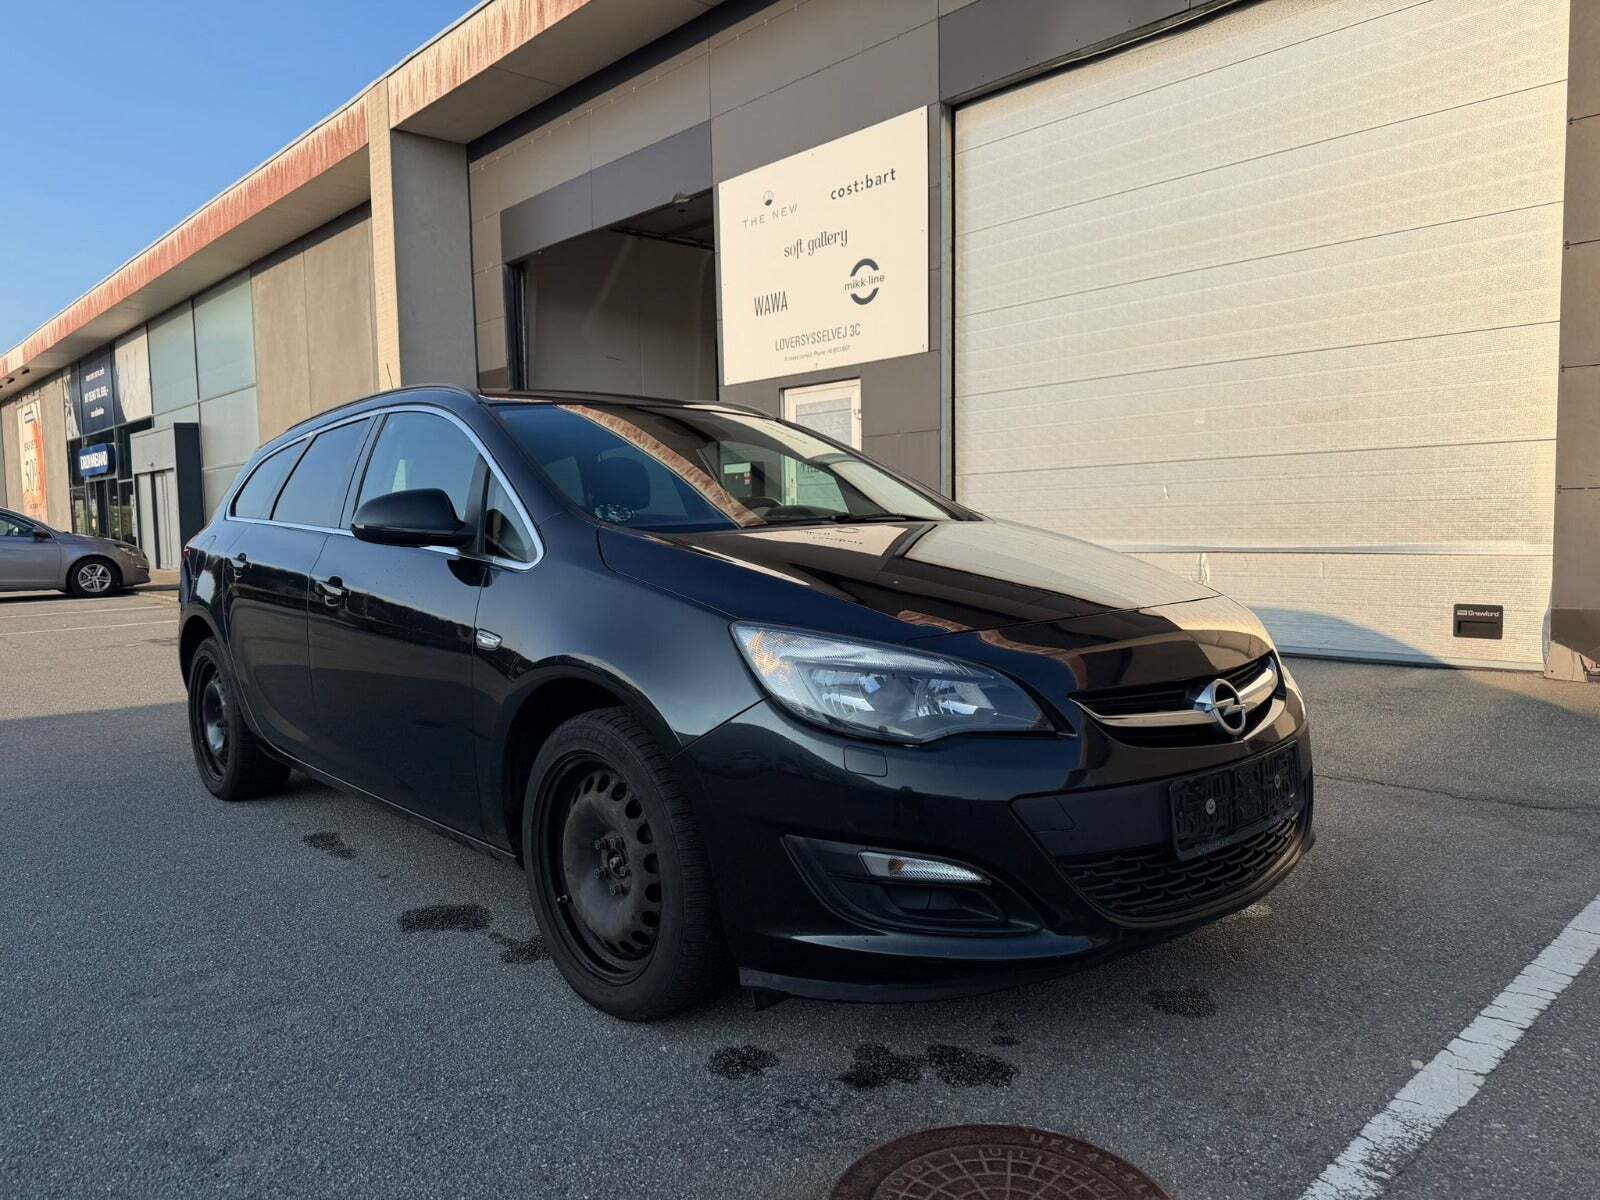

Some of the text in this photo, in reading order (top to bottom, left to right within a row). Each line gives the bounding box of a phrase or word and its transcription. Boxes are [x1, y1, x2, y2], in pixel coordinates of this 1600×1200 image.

[830, 168, 896, 200] cost:bart
[743, 203, 798, 229] THE NEW
[784, 229, 848, 260] soft gallery
[754, 291, 788, 317] WAWA
[850, 323, 861, 337] 3C
